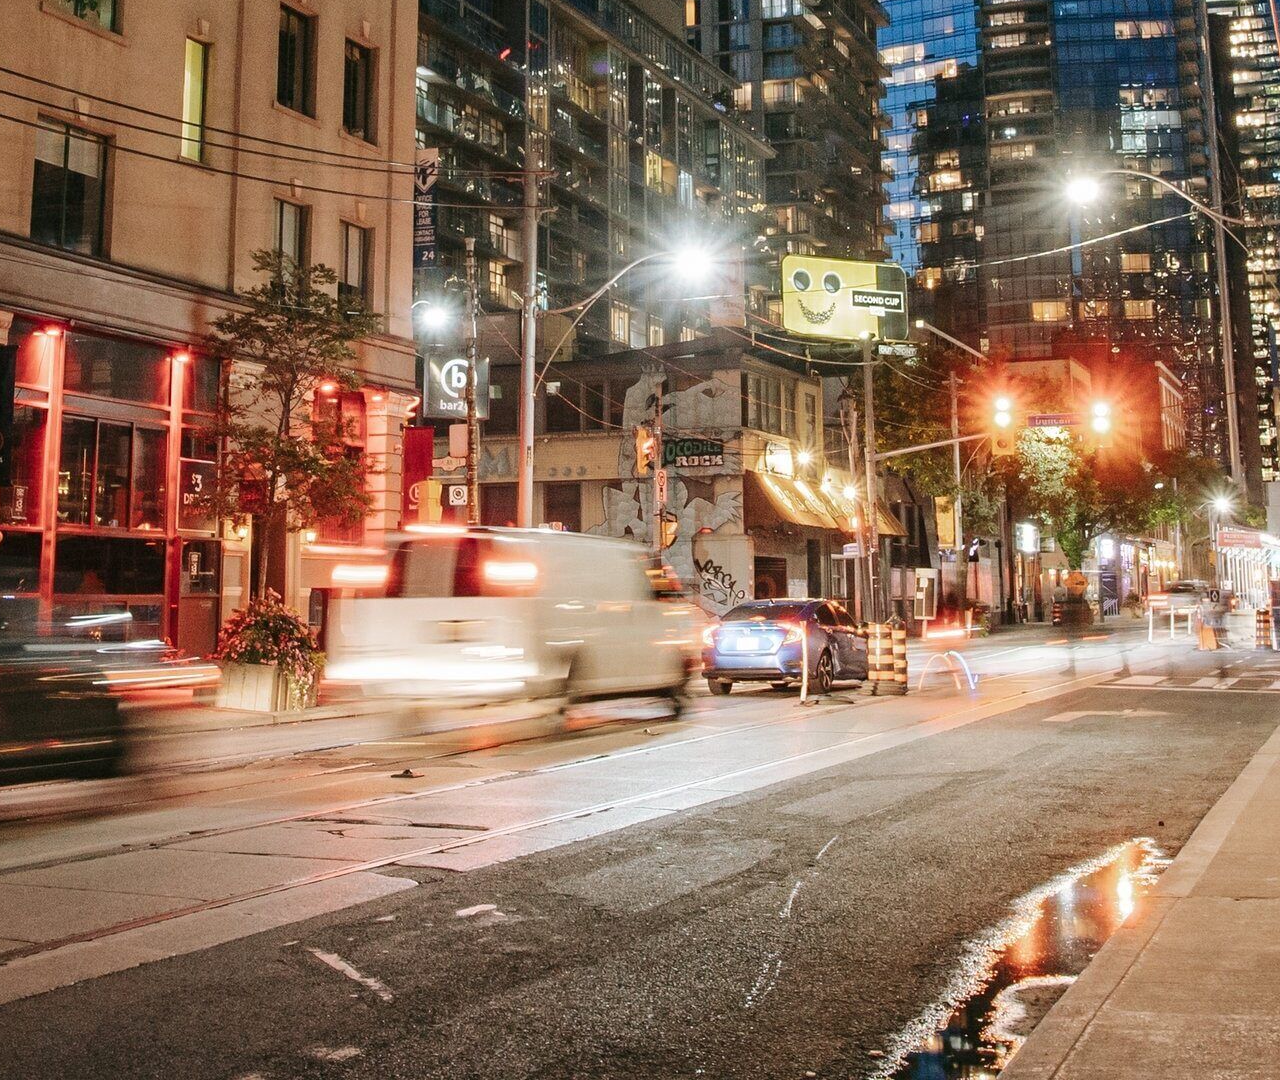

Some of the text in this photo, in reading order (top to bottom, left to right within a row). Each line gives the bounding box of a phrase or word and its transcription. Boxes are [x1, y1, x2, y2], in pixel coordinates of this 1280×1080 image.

[422, 251, 435, 260] 24
[854, 295, 900, 306] SECOND CUP
[1035, 416, 1071, 426] Duncan
[675, 455, 724, 467] ROCK
